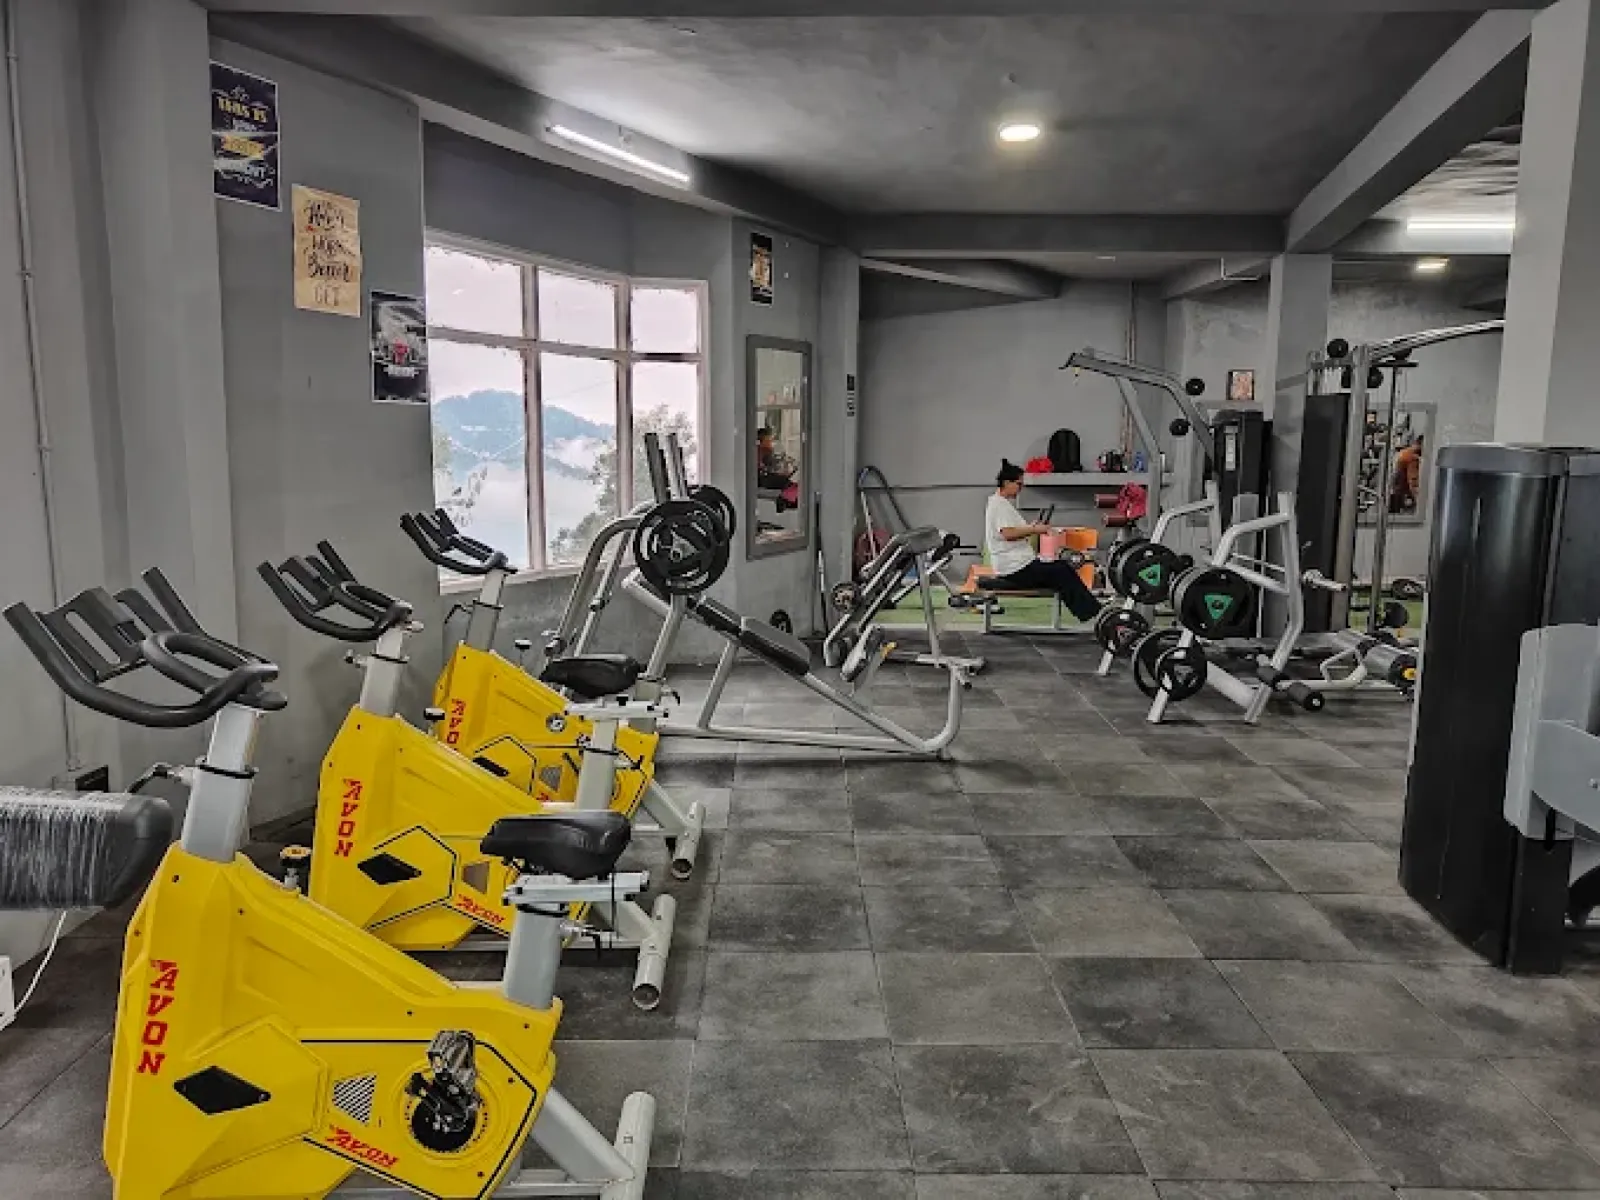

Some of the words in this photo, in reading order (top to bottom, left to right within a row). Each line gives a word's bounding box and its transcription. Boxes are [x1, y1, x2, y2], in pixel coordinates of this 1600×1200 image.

[445, 698, 466, 751] AVO
[333, 778, 362, 857] AVON
[456, 894, 505, 923] AVON
[136, 959, 179, 1075] AVON
[326, 1124, 398, 1168] AVON
